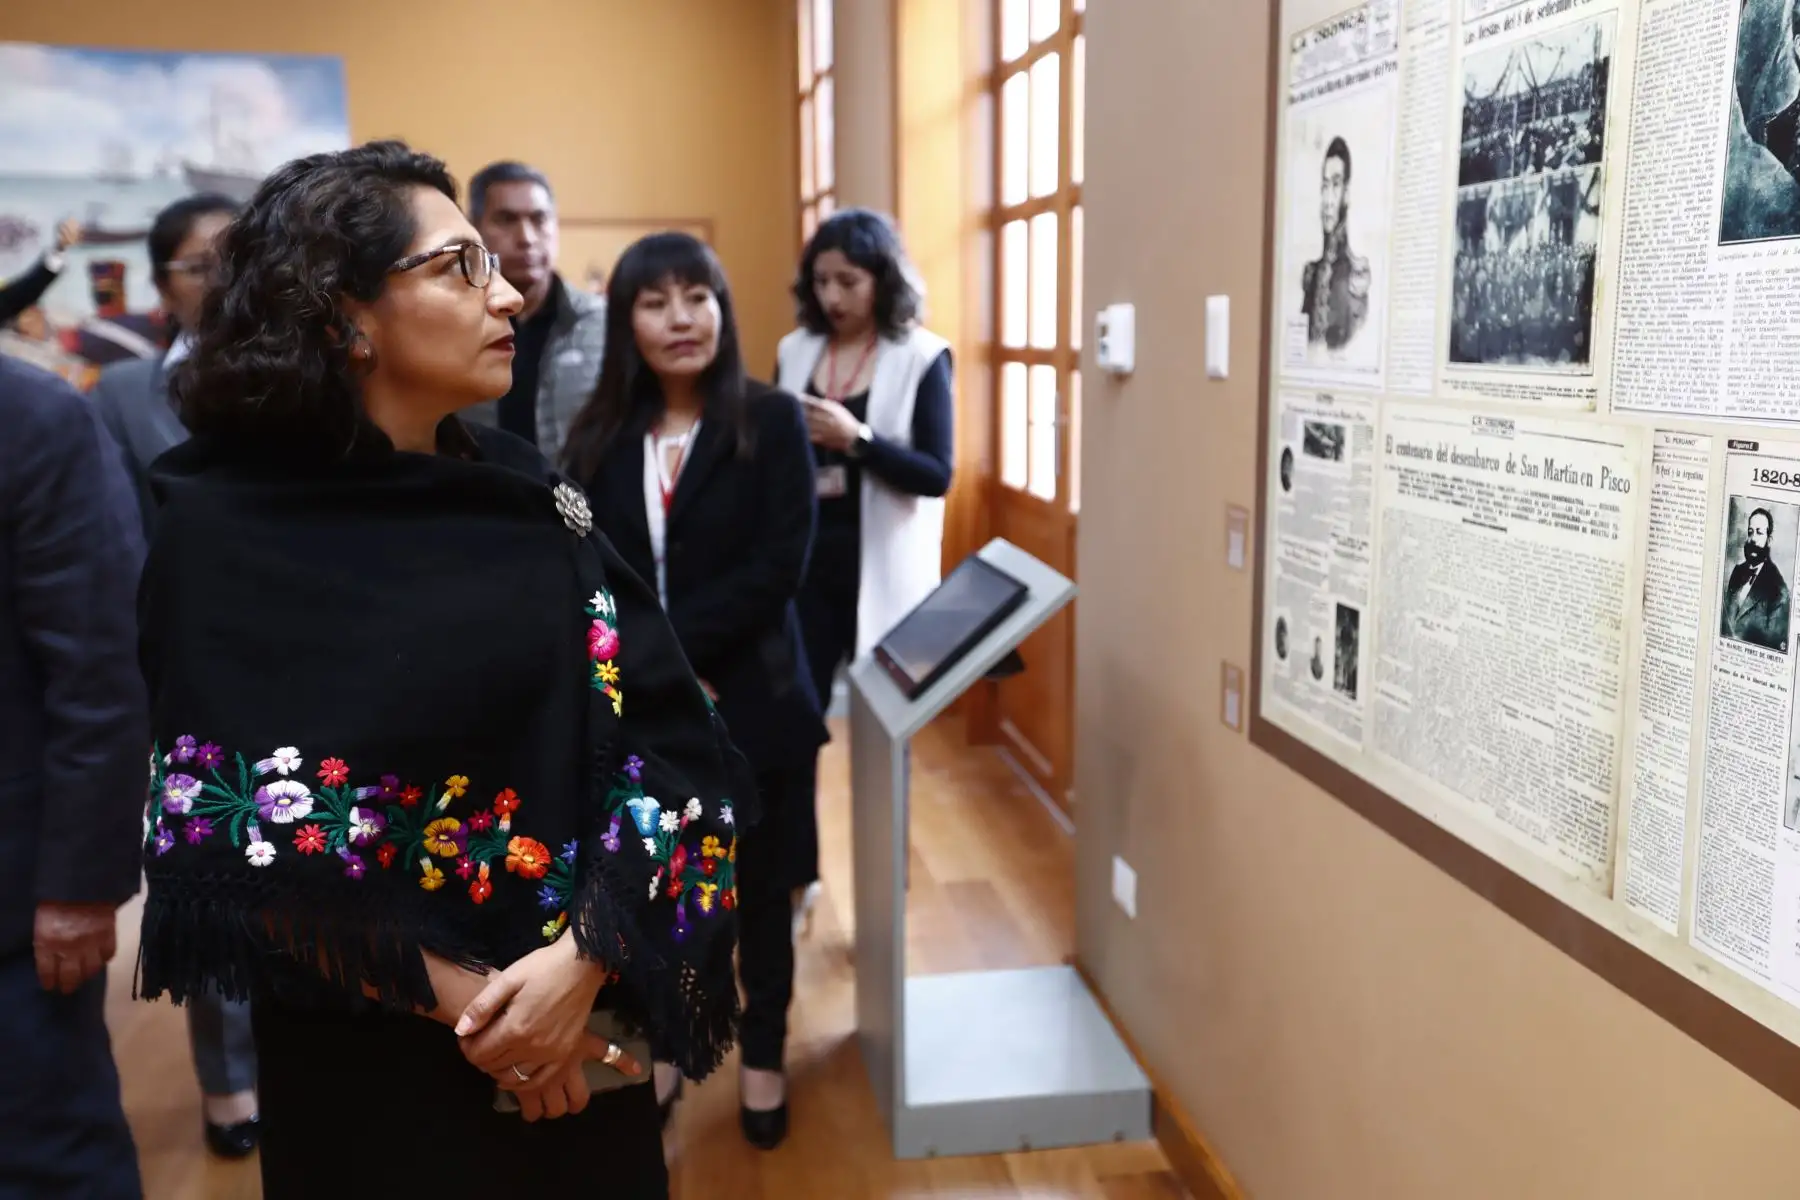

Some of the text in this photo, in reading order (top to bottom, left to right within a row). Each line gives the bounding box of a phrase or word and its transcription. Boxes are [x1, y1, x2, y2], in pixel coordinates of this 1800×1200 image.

[1386, 433, 1632, 495] El centenario del desembarco de San Martín en Pisco
